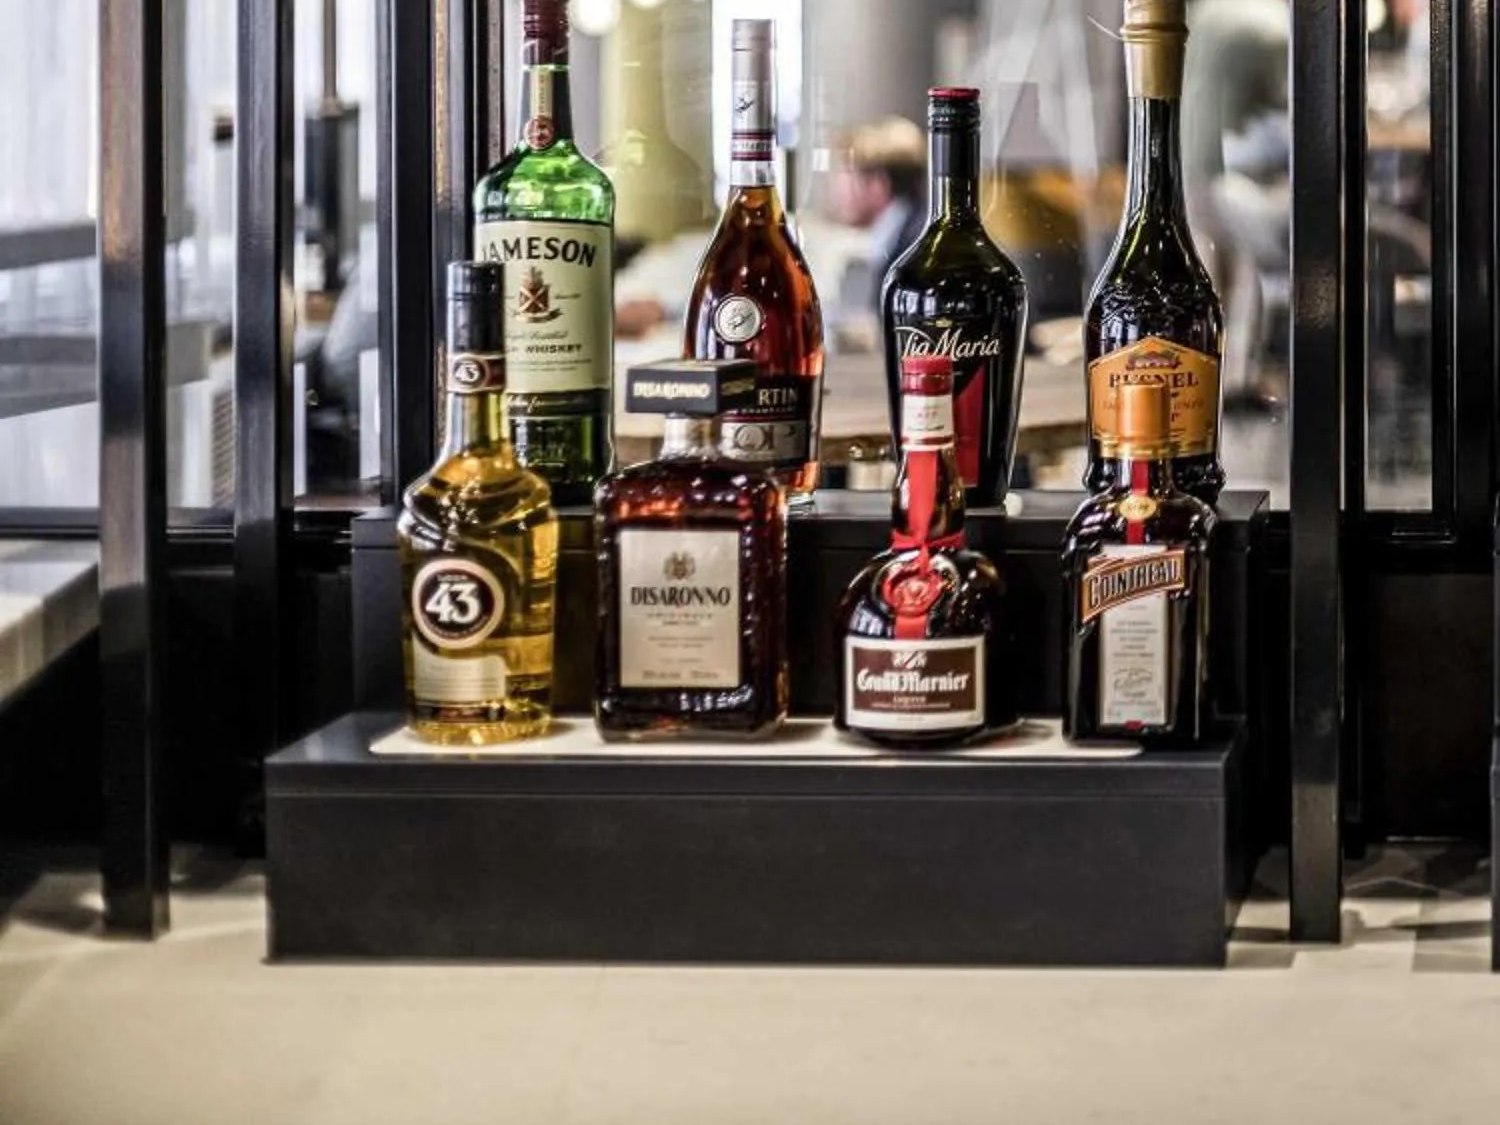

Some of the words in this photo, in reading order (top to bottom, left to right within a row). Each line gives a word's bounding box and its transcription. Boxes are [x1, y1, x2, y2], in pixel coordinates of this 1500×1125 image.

[525, 344, 583, 354] WHISKEY
[895, 326, 936, 359] Tia
[932, 327, 1000, 362] Maria
[757, 387, 799, 406] RTIN
[1089, 558, 1181, 608] COINTREAU
[425, 581, 480, 623] 43
[630, 586, 731, 606] DISARONNO
[902, 669, 970, 692] Marnier
